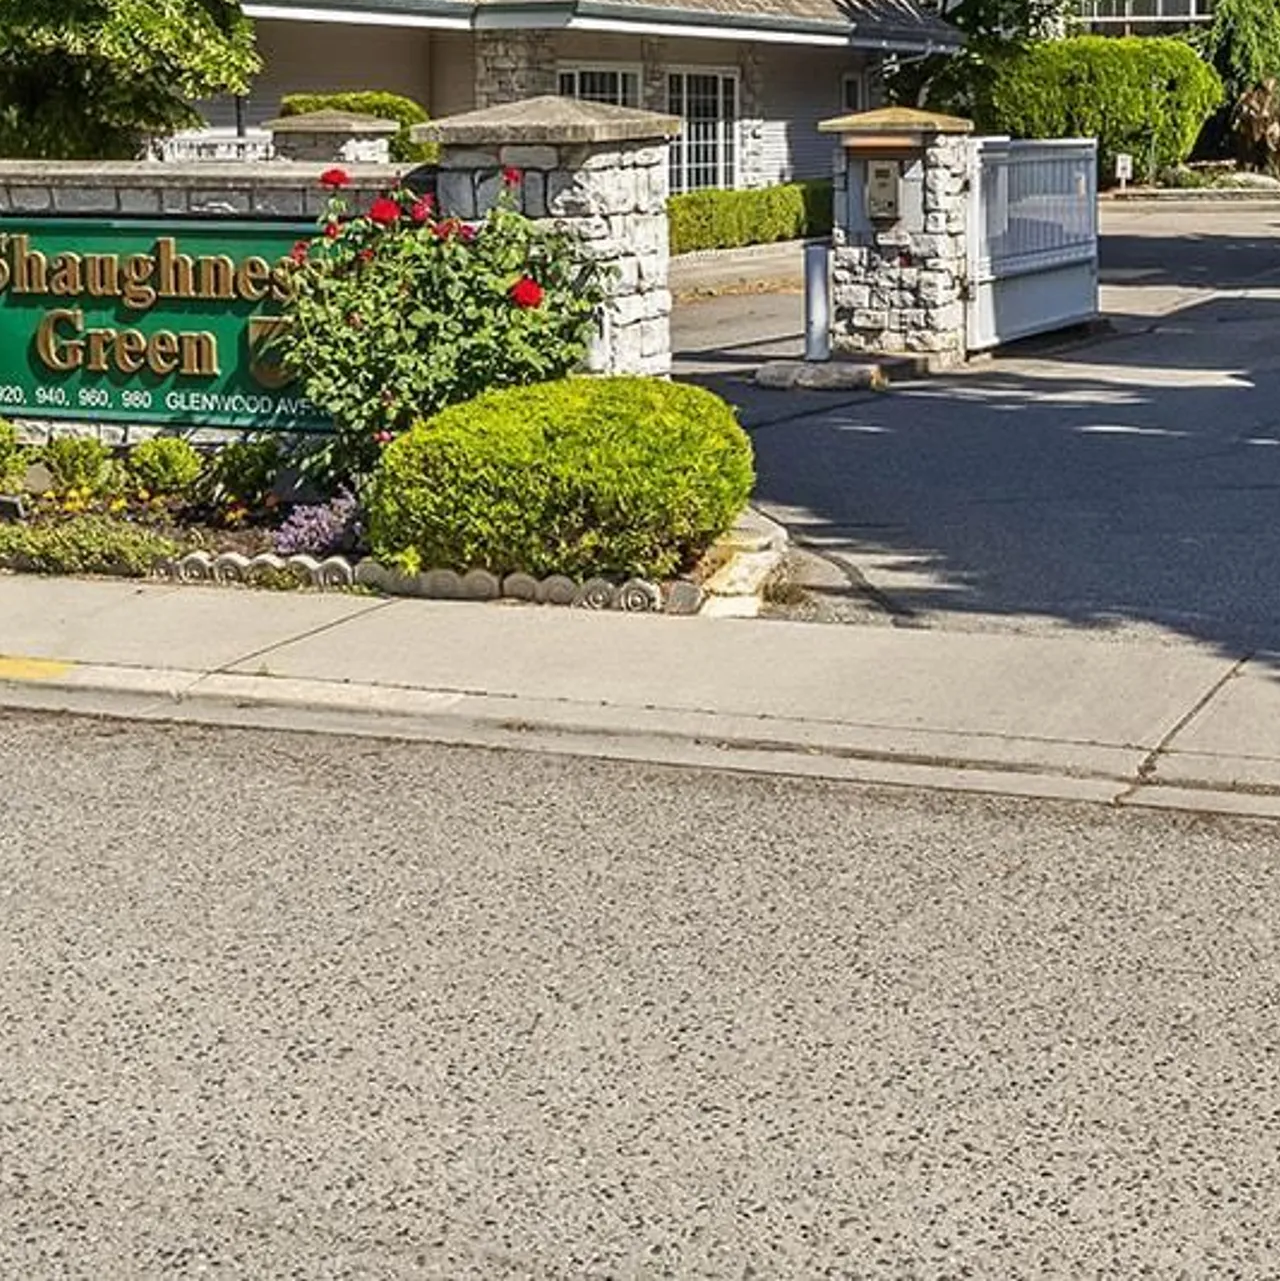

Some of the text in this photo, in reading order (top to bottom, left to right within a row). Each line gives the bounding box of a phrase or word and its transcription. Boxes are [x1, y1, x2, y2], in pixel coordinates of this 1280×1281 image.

[37, 307, 221, 376] Green
[35, 387, 70, 407] 940,
[165, 391, 273, 414] GLENWOOD
